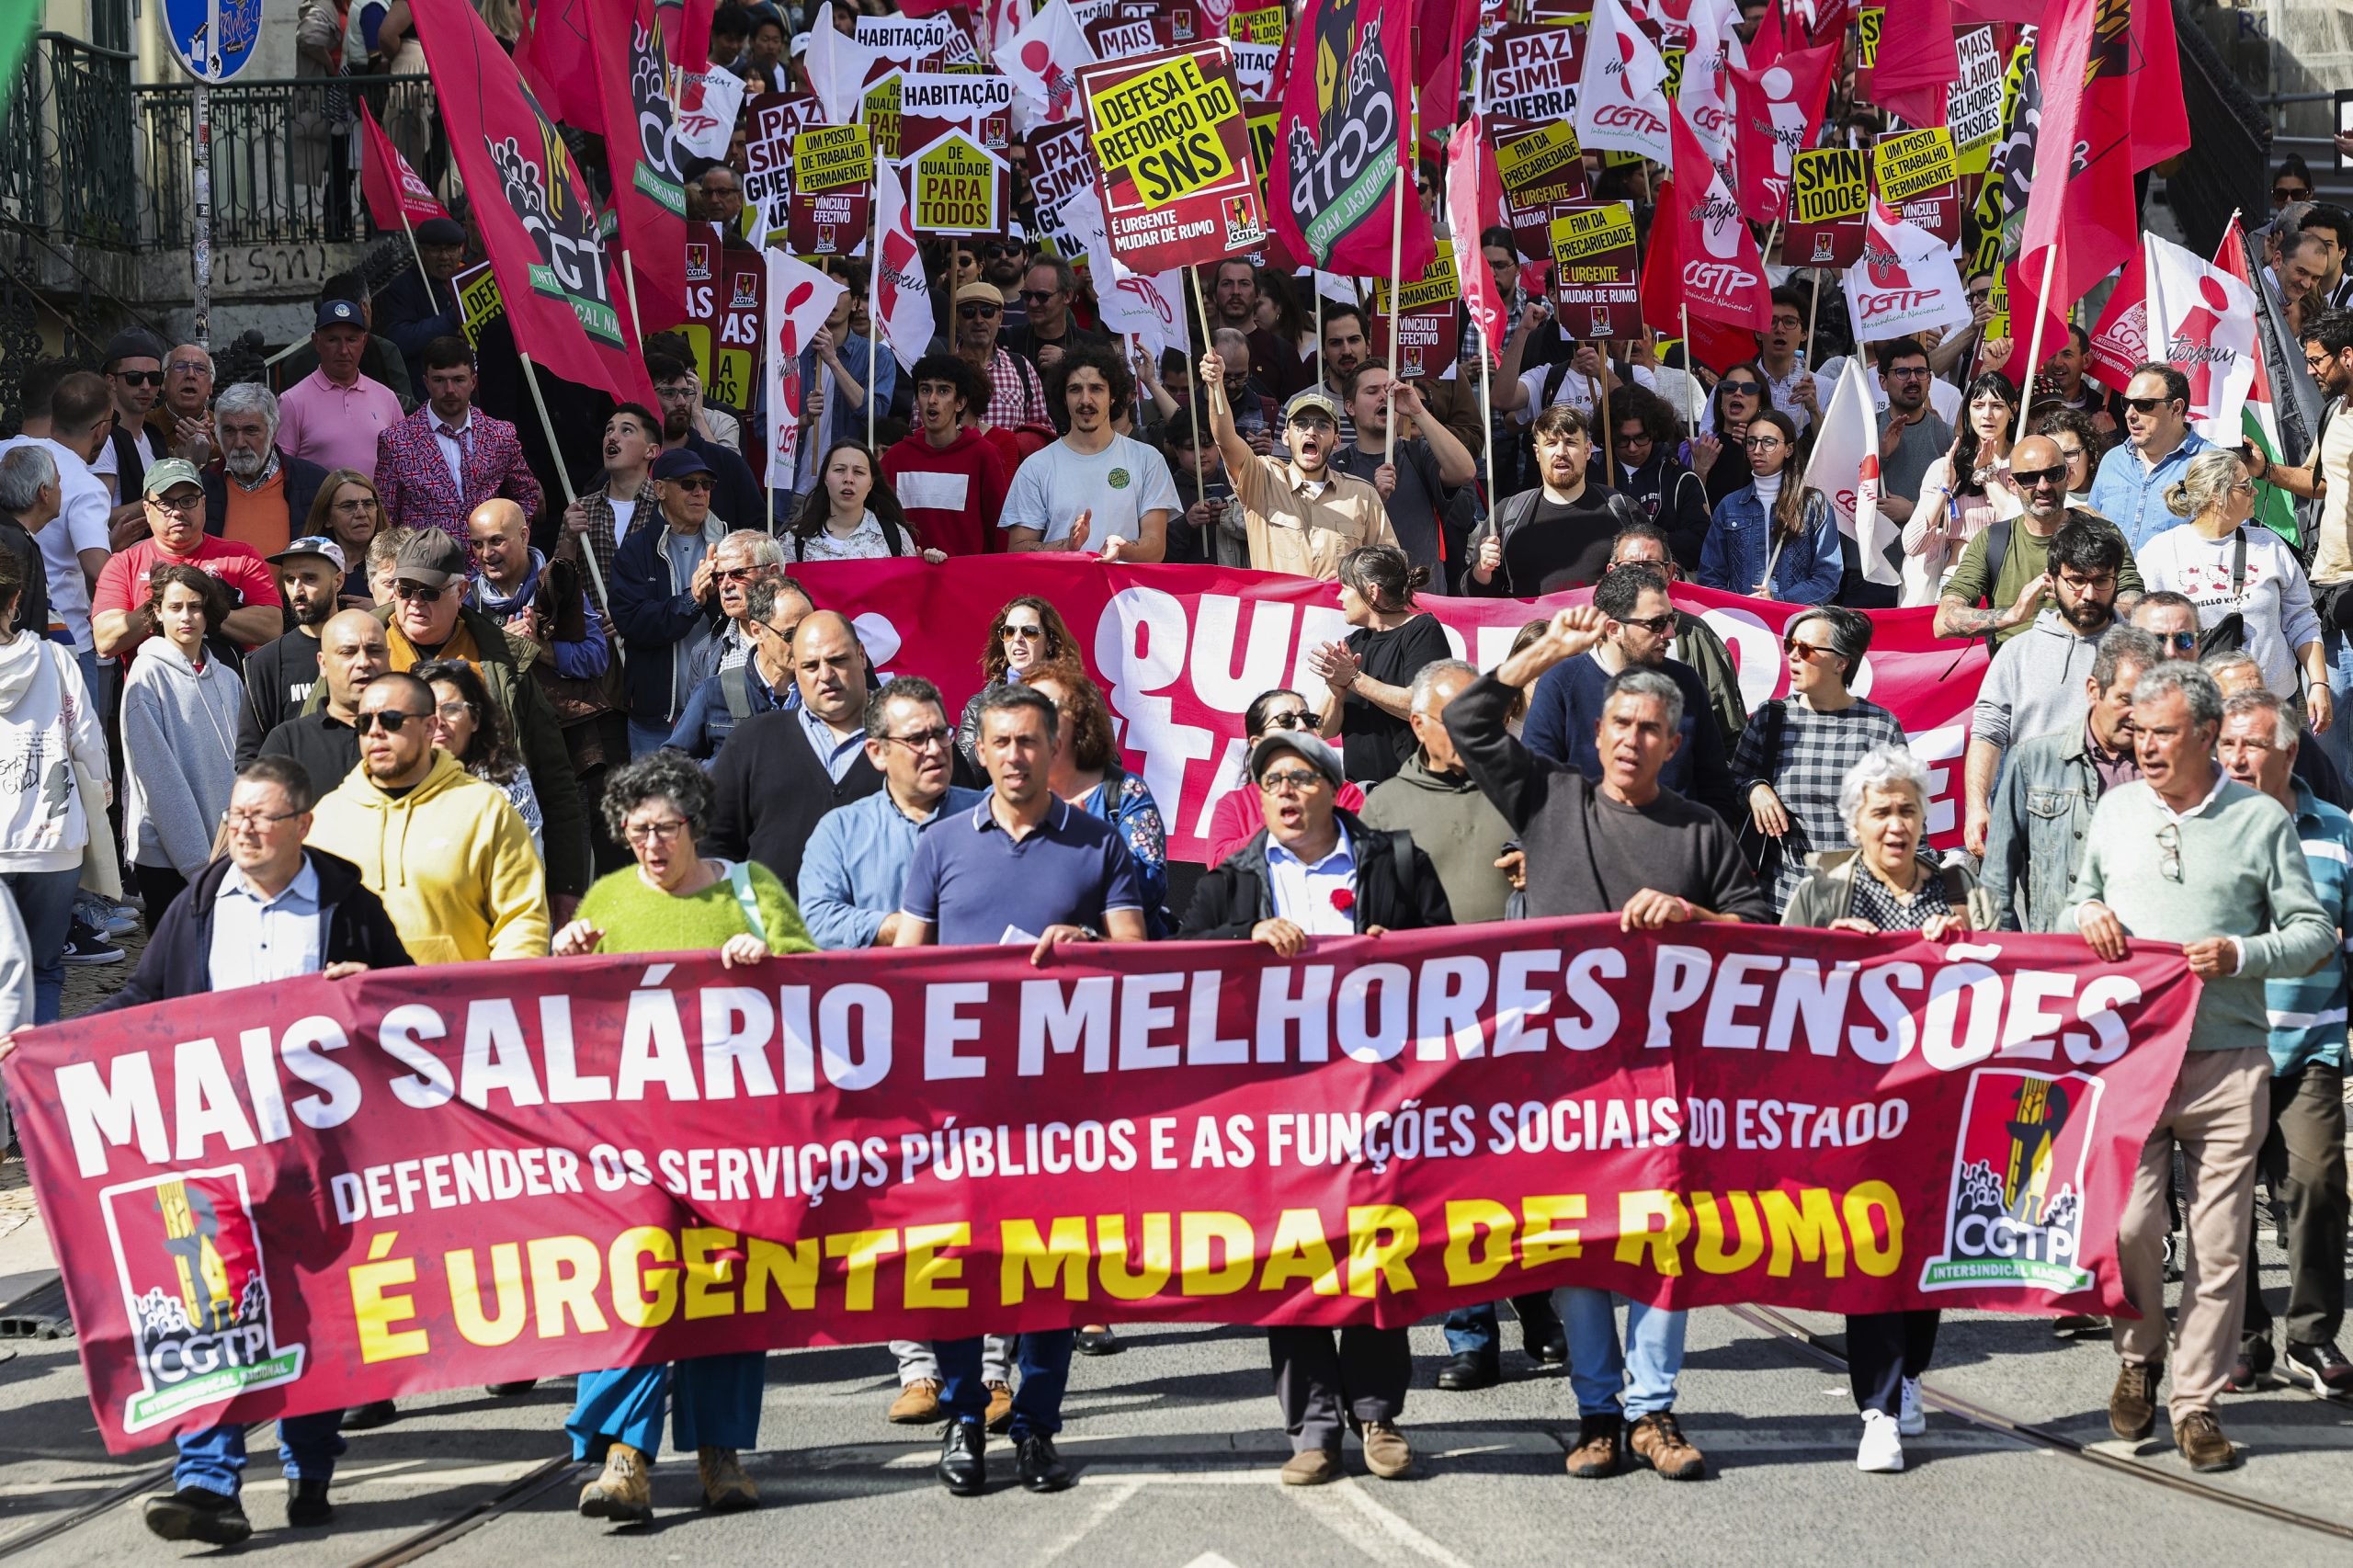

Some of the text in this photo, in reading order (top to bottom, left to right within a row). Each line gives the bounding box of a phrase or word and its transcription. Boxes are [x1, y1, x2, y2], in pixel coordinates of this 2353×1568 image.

[858, 23, 944, 51] HABITAÇÃO
[1102, 24, 1151, 55] MAIS
[1232, 25, 1281, 42] GEAL DOS
[1958, 29, 1992, 65] MAIS
[1509, 32, 1569, 68] PAZ
[904, 78, 1009, 108] HABITAÇÃO
[1100, 71, 1186, 128] DEFESA
[1180, 62, 1201, 91] E
[1495, 62, 1560, 98] SIM!
[762, 99, 821, 136] PAZ
[866, 97, 901, 111] QUALID
[1491, 87, 1577, 119] GUERRA
[1947, 81, 2002, 124] MELHORES
[870, 112, 901, 133] PAR
[1098, 101, 1199, 167] REFORÇO
[1196, 85, 1232, 123] DO
[1593, 104, 1667, 134] CGTP
[1958, 107, 1999, 143] ENSÕES
[805, 127, 856, 151] UM POSTO
[948, 146, 963, 160] DE
[1040, 127, 1090, 172] PAZ
[1514, 131, 1551, 159] FIM DA
[1884, 130, 1937, 160] UM POSTO
[749, 136, 795, 173] SIM
[801, 143, 865, 170] DE TRABALHO
[920, 161, 990, 176] QUALIDADE
[1138, 132, 1222, 201] SNS
[1505, 141, 1579, 187] PRECARIEDADE
[1881, 145, 1949, 180] DE TRABALHO
[803, 163, 869, 189] PERMANENTE
[1036, 158, 1094, 205] SIM!
[1797, 150, 1862, 191] SMN
[1887, 164, 1955, 199] PERMANENTE
[815, 196, 850, 210] VÍNCULO
[926, 178, 982, 201] PARA
[1512, 183, 1570, 208] É URGENTE
[1802, 184, 1867, 219] 1000€
[813, 210, 850, 223] EFECTIVO
[920, 201, 987, 225] TODOS
[1111, 209, 1177, 235] É URGENTE
[1513, 210, 1547, 229] MUDAR
[1570, 210, 1607, 234] FIM DA
[1902, 201, 1939, 218] VÍNCULO
[1114, 219, 1215, 253] MUDAR DE RUMO
[1230, 228, 1258, 242] CGTP
[1557, 226, 1634, 260] PRECARIEDADE
[687, 268, 707, 277] CGTP
[1563, 263, 1620, 282] É URGENTE
[1683, 259, 1758, 296] CGTP
[467, 278, 498, 315] DEF
[1385, 280, 1455, 310] PRMANENTE
[1560, 289, 1637, 303] MUDAR DE RUMO
[1717, 298, 1754, 313] Nacional
[1858, 289, 1941, 318] CGTP
[1399, 316, 1438, 331] VÍNCULO
[1907, 303, 1946, 318] Nacional
[1398, 333, 1438, 346] EFECTIVO
[290, 684, 315, 703] NW
[54, 943, 2143, 1179] MAIS SALÁRIO E MELHORES PENSÕES
[330, 1146, 583, 1226] DEFENDER
[658, 1135, 888, 1208] SERVIÇOS
[901, 1117, 1138, 1185] PÚBLICOS
[1150, 1117, 1178, 1170] E
[1190, 1113, 1256, 1170] AS
[1267, 1099, 1475, 1176] FUNÇÕES
[1487, 1096, 1681, 1155] SOCIAIS
[1689, 1096, 1727, 1151] DO
[1735, 1096, 1909, 1152] ESTADO
[1955, 1213, 2074, 1266] CGTP
[347, 1179, 1905, 1366] É URGENTE MUDAR DE RUMO
[1933, 1264, 2028, 1279] INTERSINDICAL
[150, 1323, 266, 1383] CGTP
